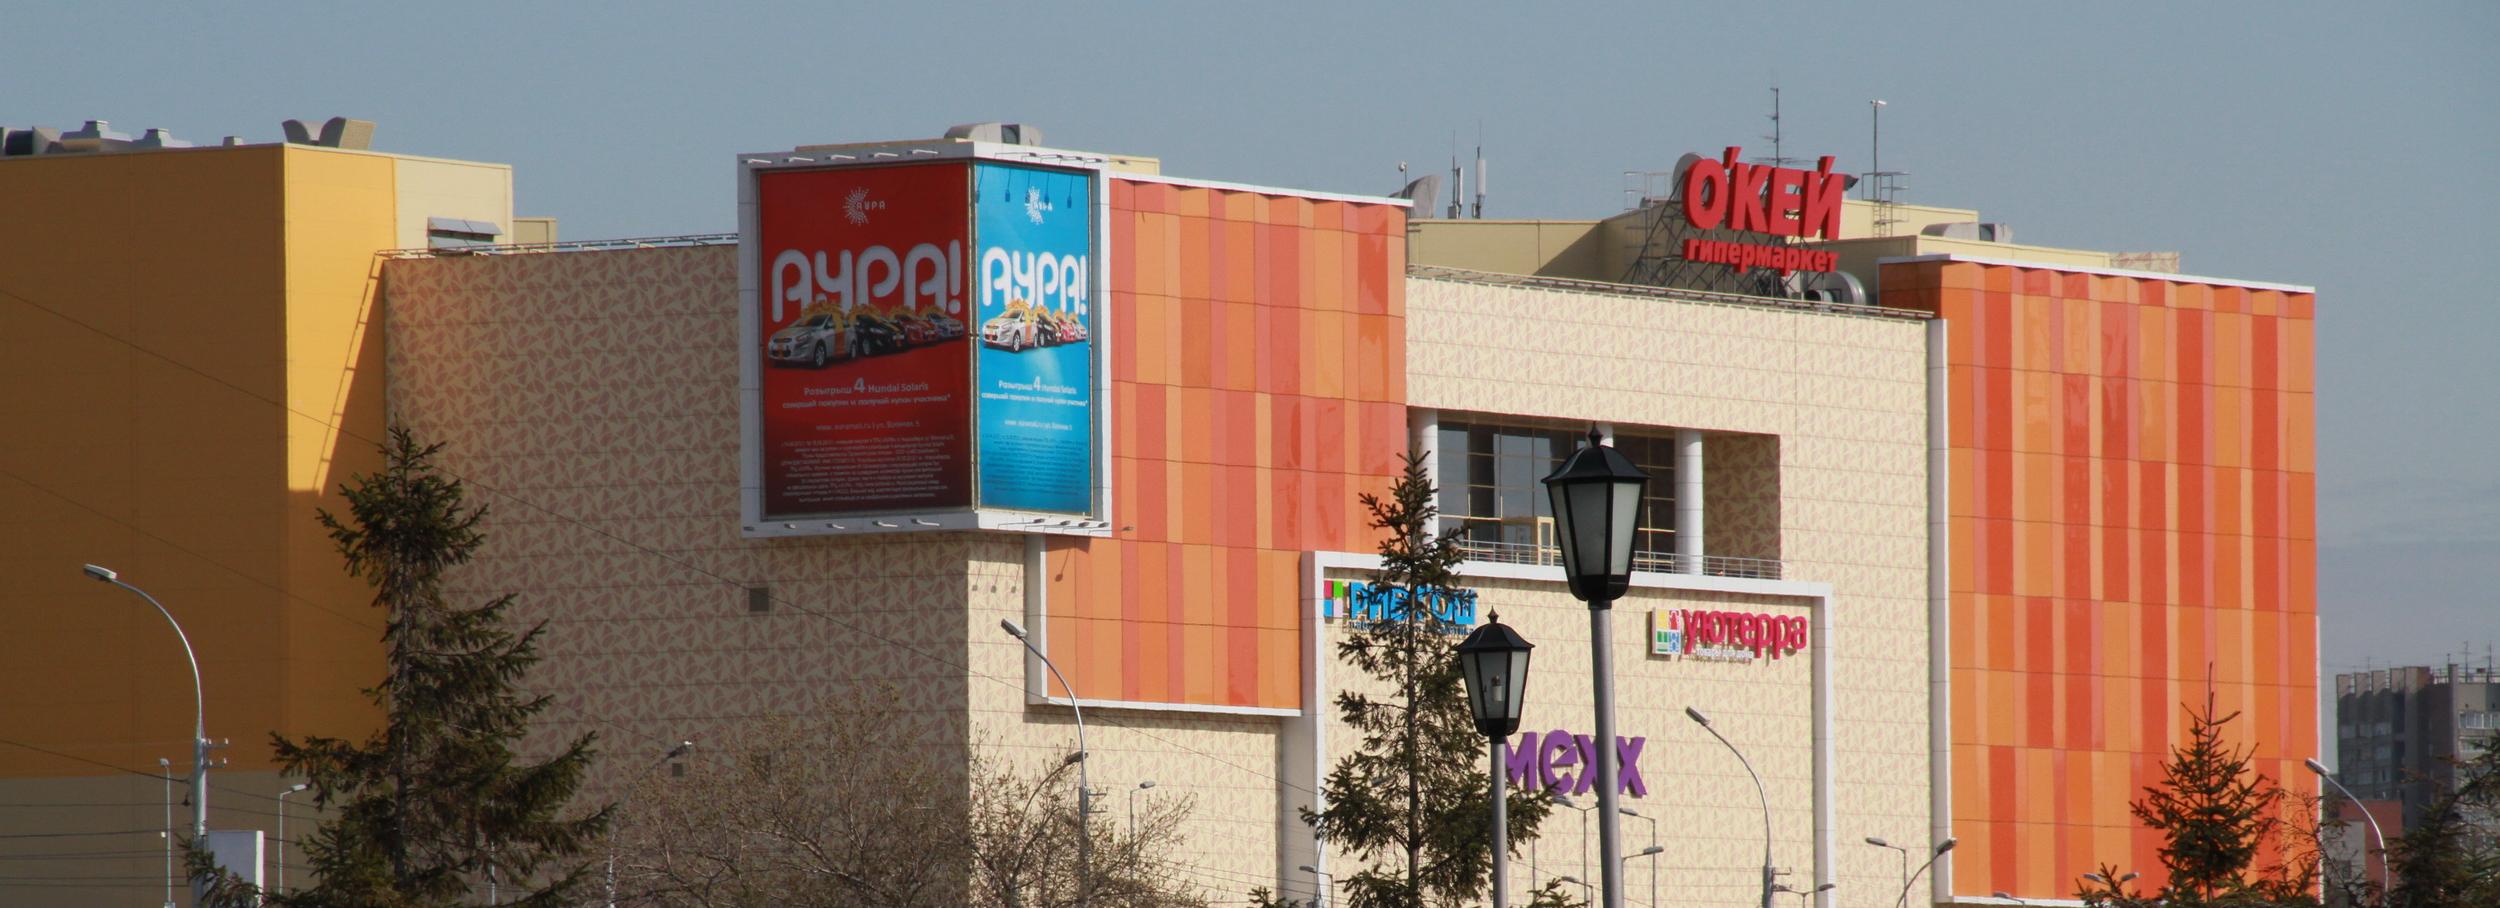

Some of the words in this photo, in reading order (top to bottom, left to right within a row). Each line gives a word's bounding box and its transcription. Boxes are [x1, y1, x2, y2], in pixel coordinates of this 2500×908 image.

[1684, 238, 1839, 276] гипермаркет
[772, 239, 961, 322] АУРА!
[982, 246, 1087, 315] АУРА!
[854, 377, 865, 392] 4
[1033, 375, 1041, 391] 4
[1681, 608, 1807, 660] уютерра
